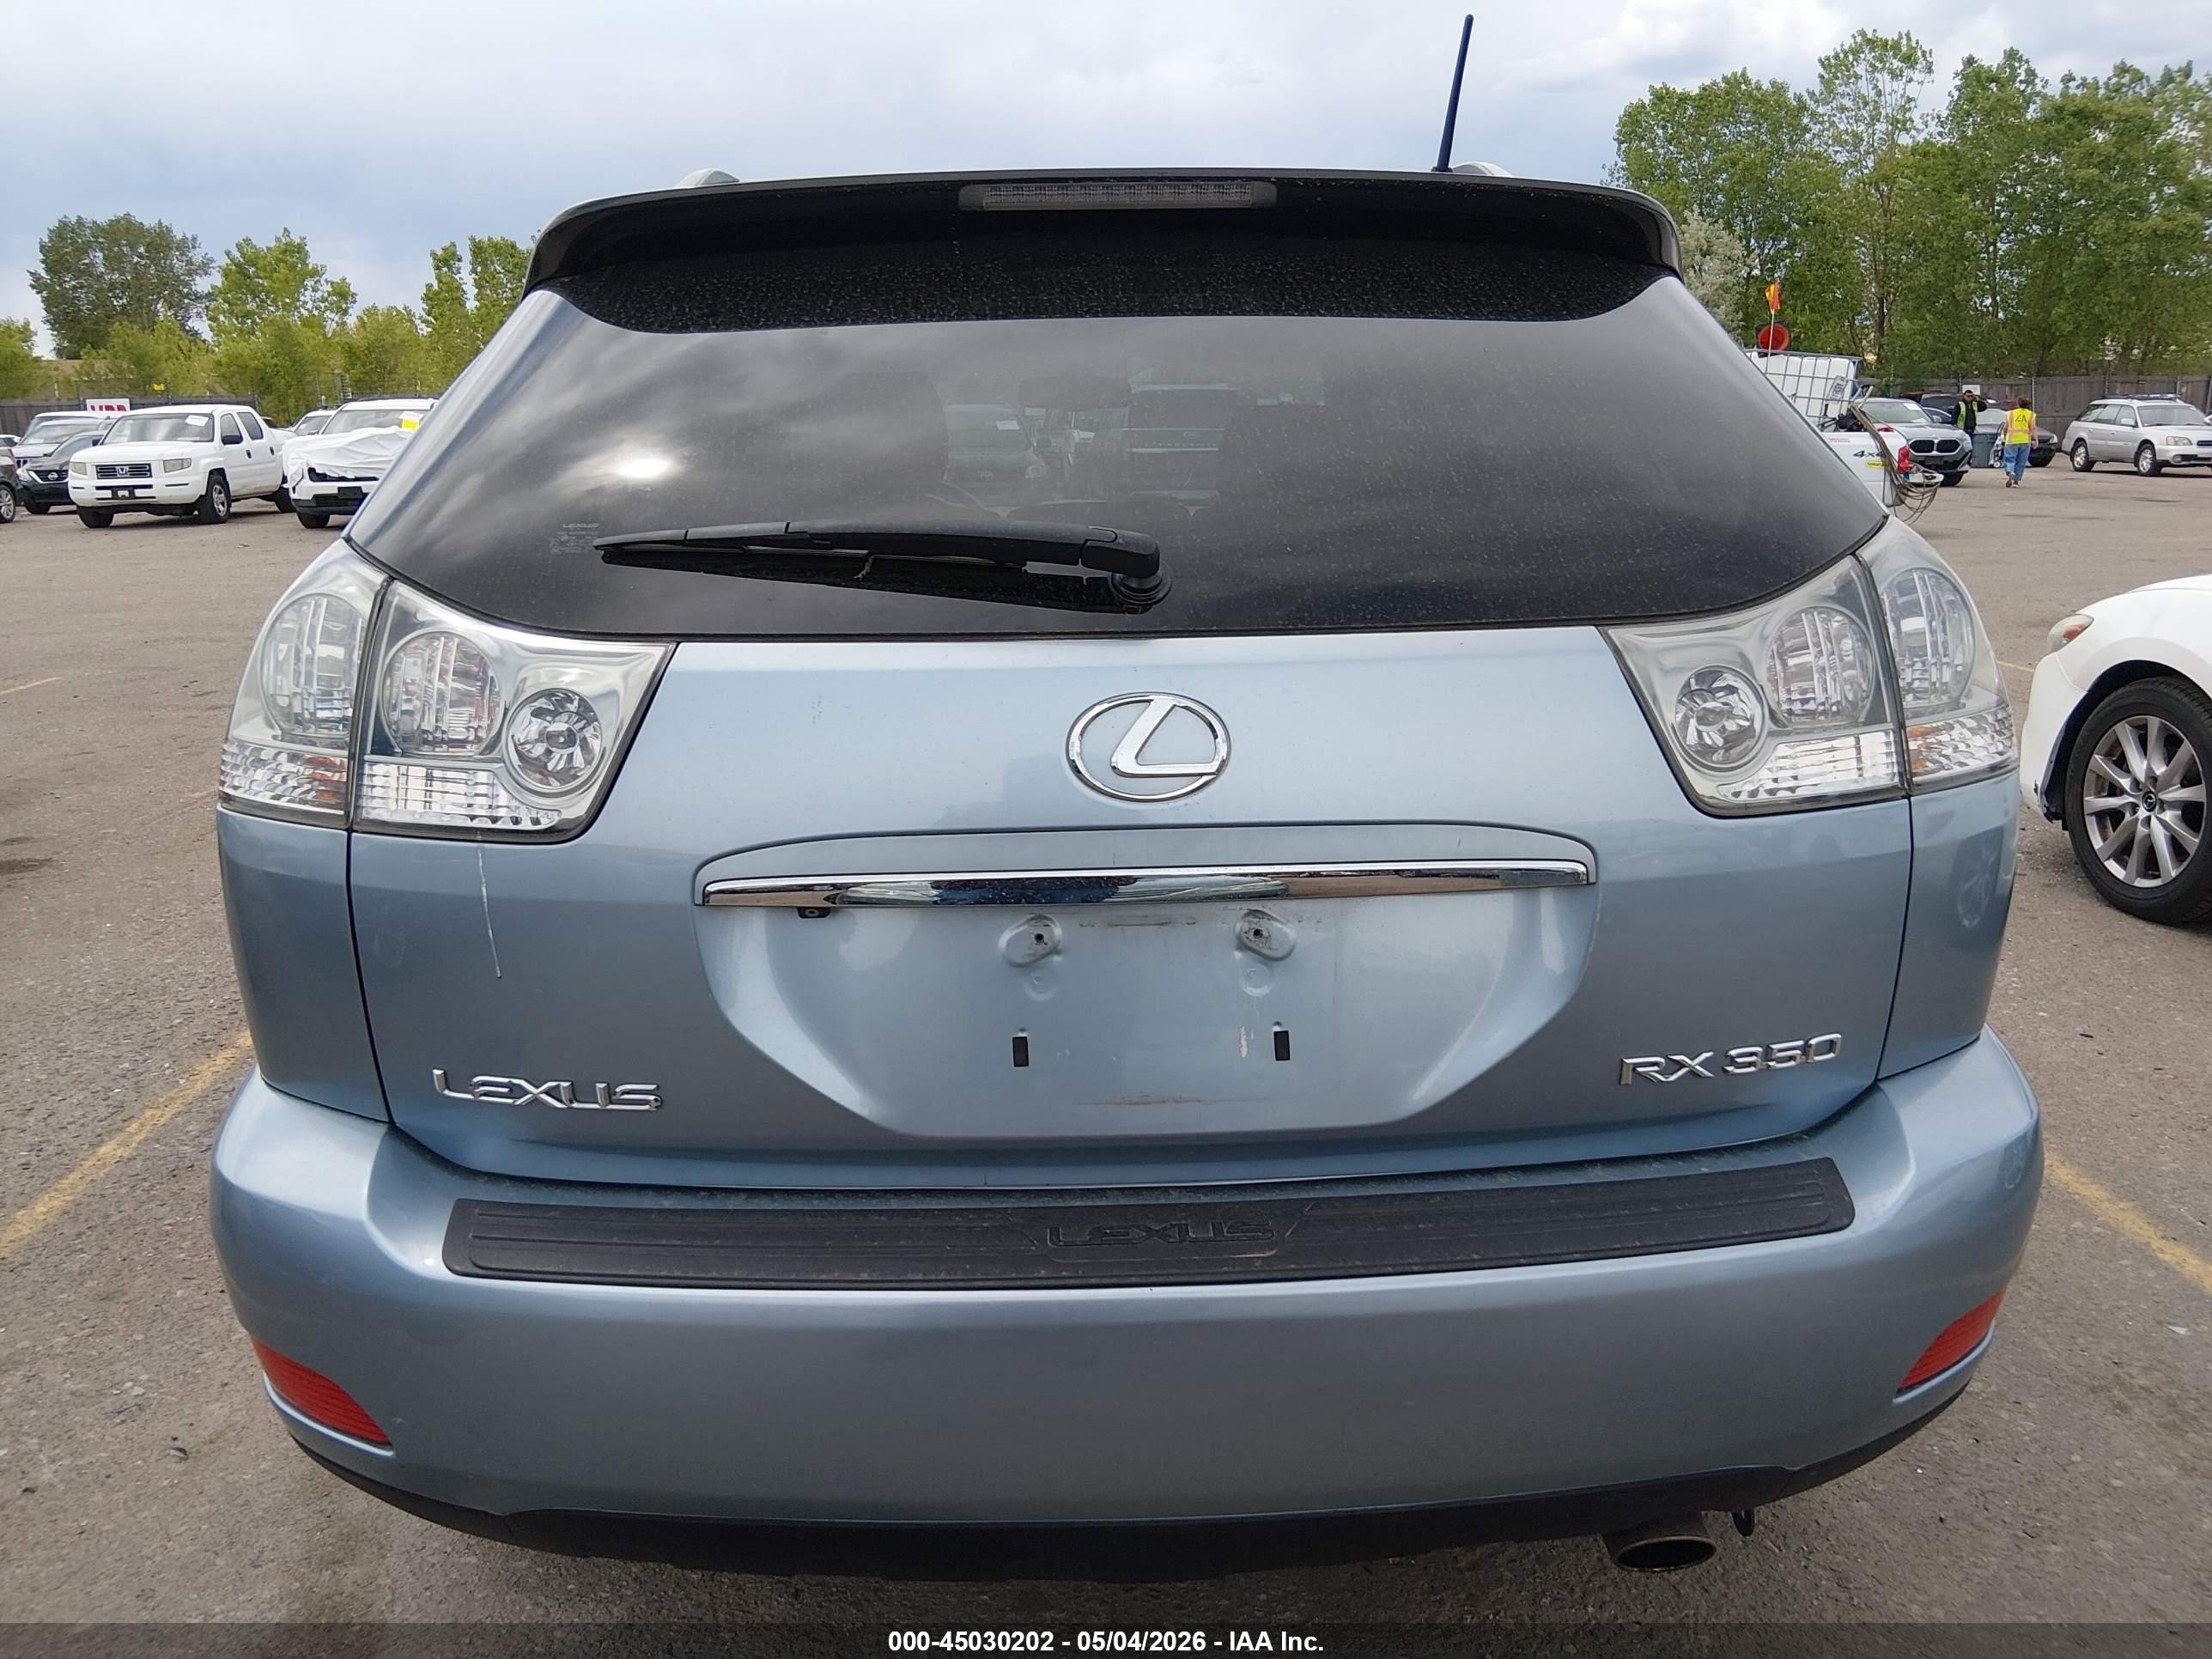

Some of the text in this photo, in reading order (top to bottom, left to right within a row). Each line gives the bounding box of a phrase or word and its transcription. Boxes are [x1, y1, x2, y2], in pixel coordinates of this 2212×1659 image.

[1620, 1033, 1842, 1085] RX 350
[433, 1068, 661, 1110] LEXUS
[1047, 1220, 1276, 1247] LEXUS
